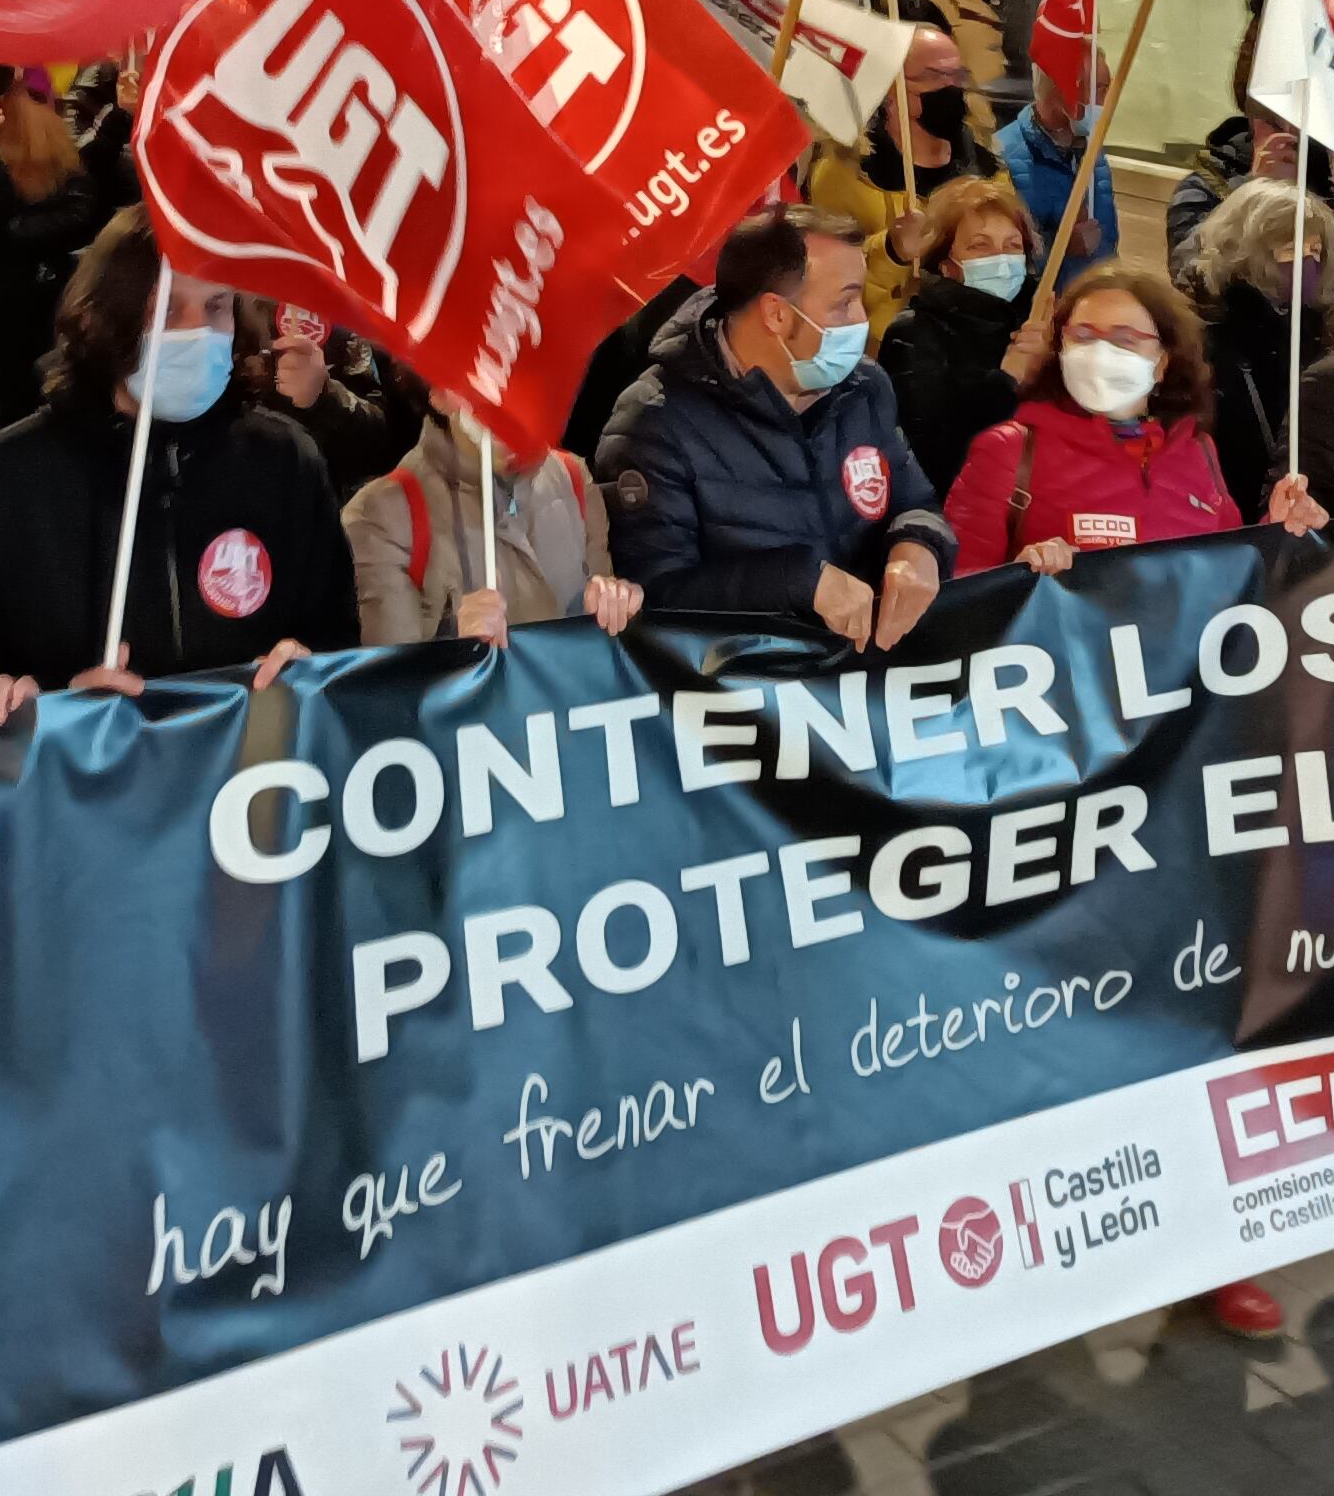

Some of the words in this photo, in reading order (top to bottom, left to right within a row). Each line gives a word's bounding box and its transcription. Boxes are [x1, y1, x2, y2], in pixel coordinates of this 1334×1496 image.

[1078, 518, 1131, 533] CCOO
[208, 643, 1070, 885] CONTENER
[352, 783, 1158, 1064] PROTEGER
[145, 1192, 293, 1300] hay
[341, 1151, 463, 1260] que
[503, 1072, 716, 1180] frenar
[759, 1016, 811, 1105] el
[850, 968, 1134, 1078] deterioro
[1172, 919, 1243, 993] de
[1044, 1143, 1163, 1208] Castilla
[1053, 1224, 1077, 1270] y
[1080, 1195, 1161, 1251] León
[1239, 1217, 1266, 1243] de
[753, 1214, 920, 1356] UGT
[544, 1319, 702, 1421] UATAE
